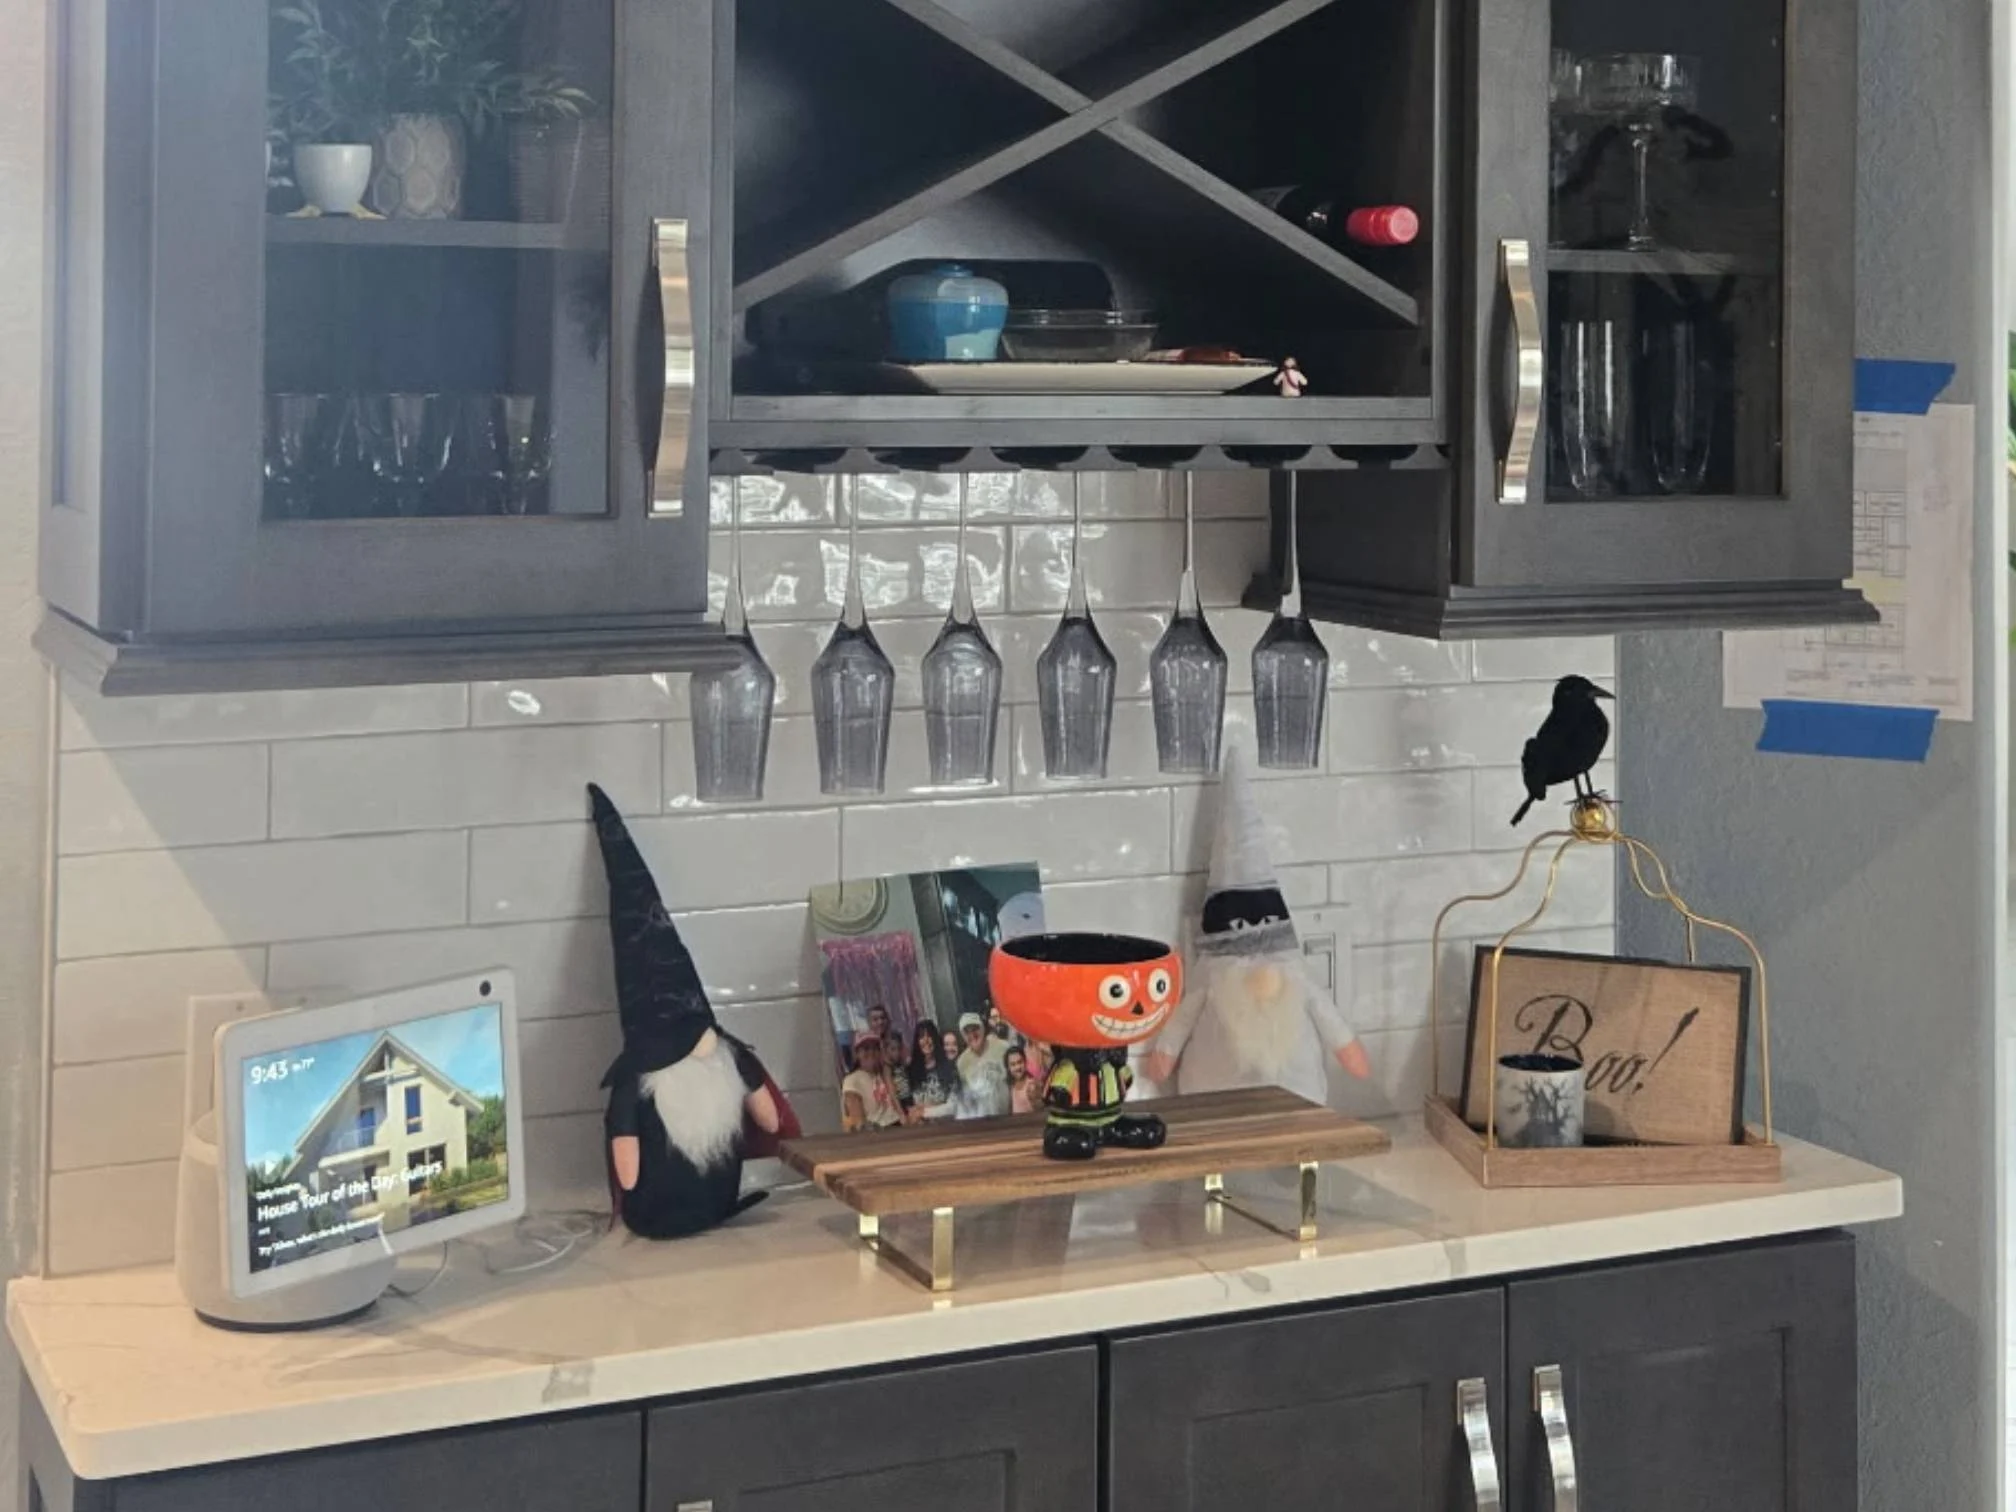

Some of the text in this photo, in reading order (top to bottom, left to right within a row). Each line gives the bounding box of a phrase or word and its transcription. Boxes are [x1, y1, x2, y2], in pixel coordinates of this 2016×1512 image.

[1515, 994, 1700, 1095] Boo!
[251, 1059, 288, 1084] 9:43
[257, 1200, 299, 1223] House
[300, 1191, 330, 1210] Tour
[331, 1182, 346, 1200] of
[349, 1180, 370, 1198] the
